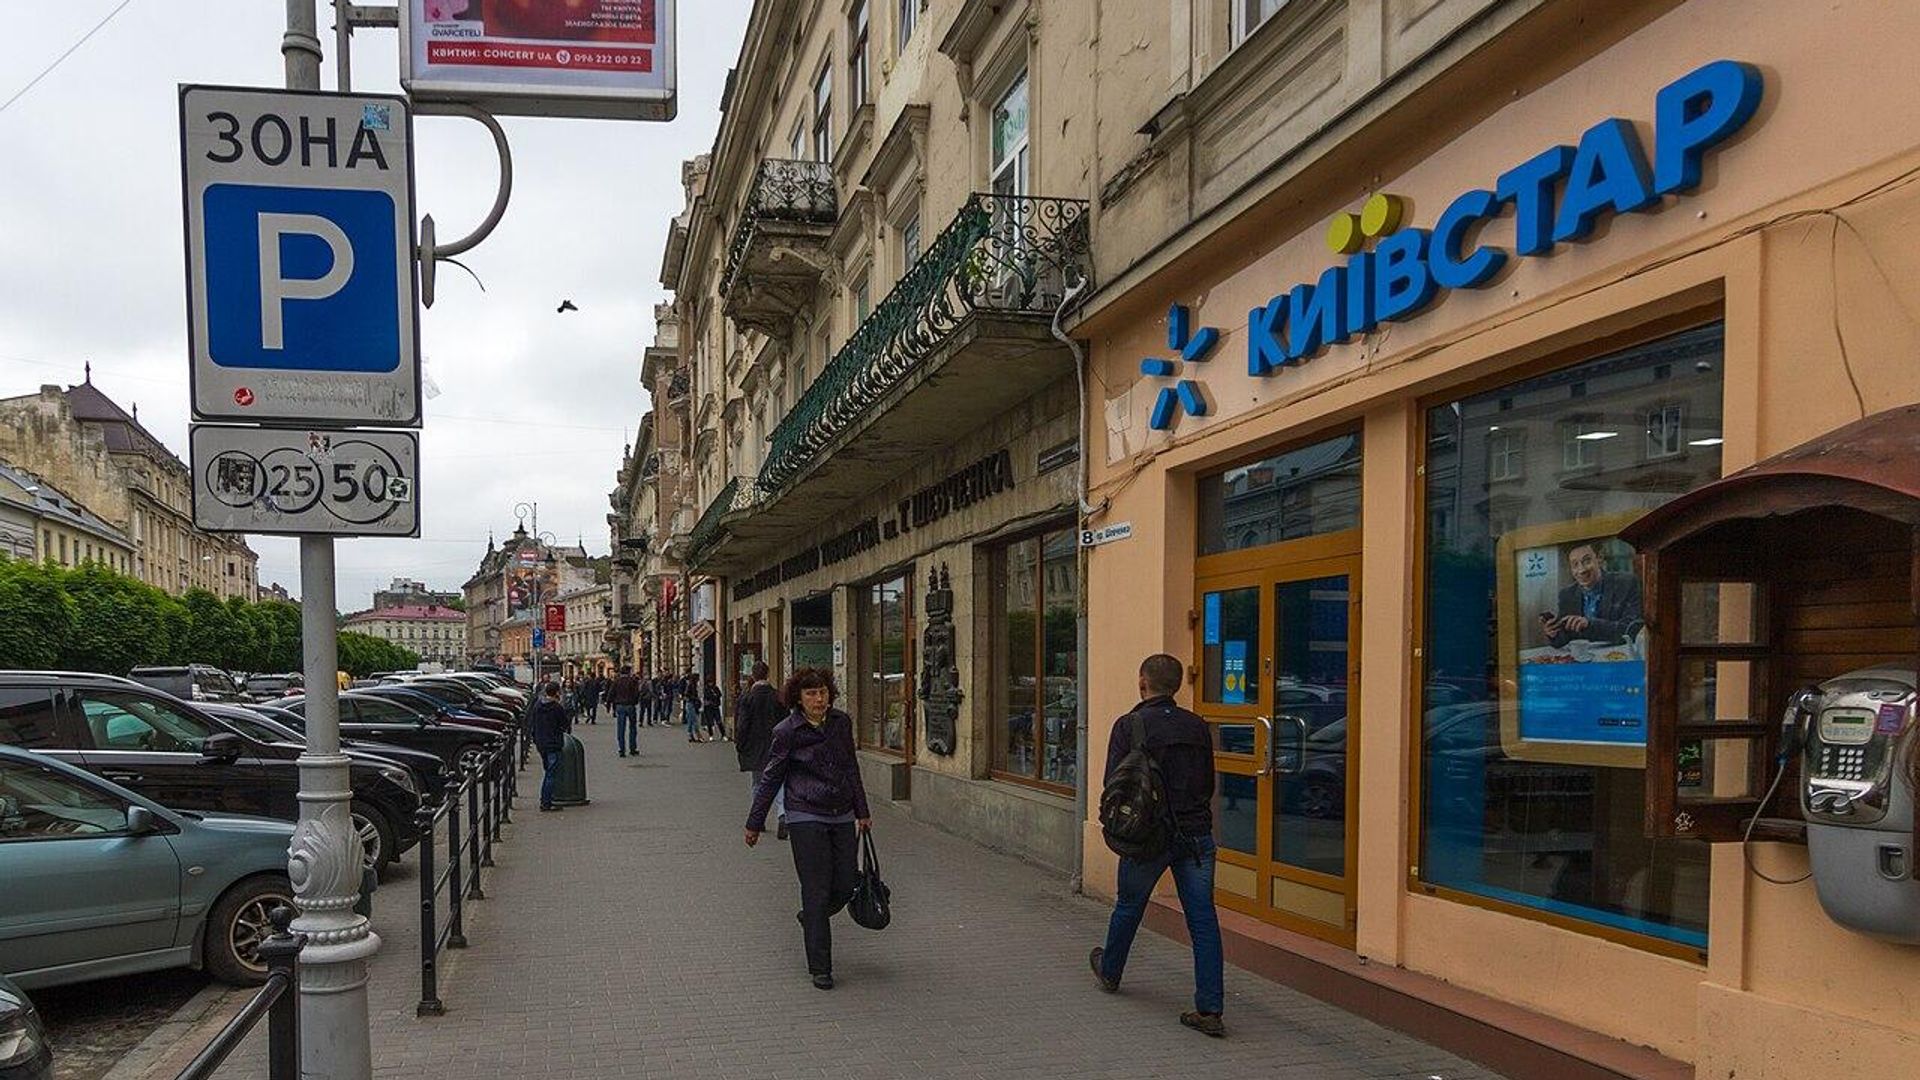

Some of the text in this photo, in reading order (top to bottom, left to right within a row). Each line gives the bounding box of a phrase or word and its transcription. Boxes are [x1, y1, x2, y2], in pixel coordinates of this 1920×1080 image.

[483, 49, 534, 60] CONCERT
[574, 53, 642, 65] 096 222 00 22
[205, 111, 389, 170] ЗОНА
[1248, 60, 1764, 377] КИЇВСТАР
[258, 212, 355, 350] P
[269, 463, 389, 504] 25 50
[1082, 531, 1093, 545] 8
